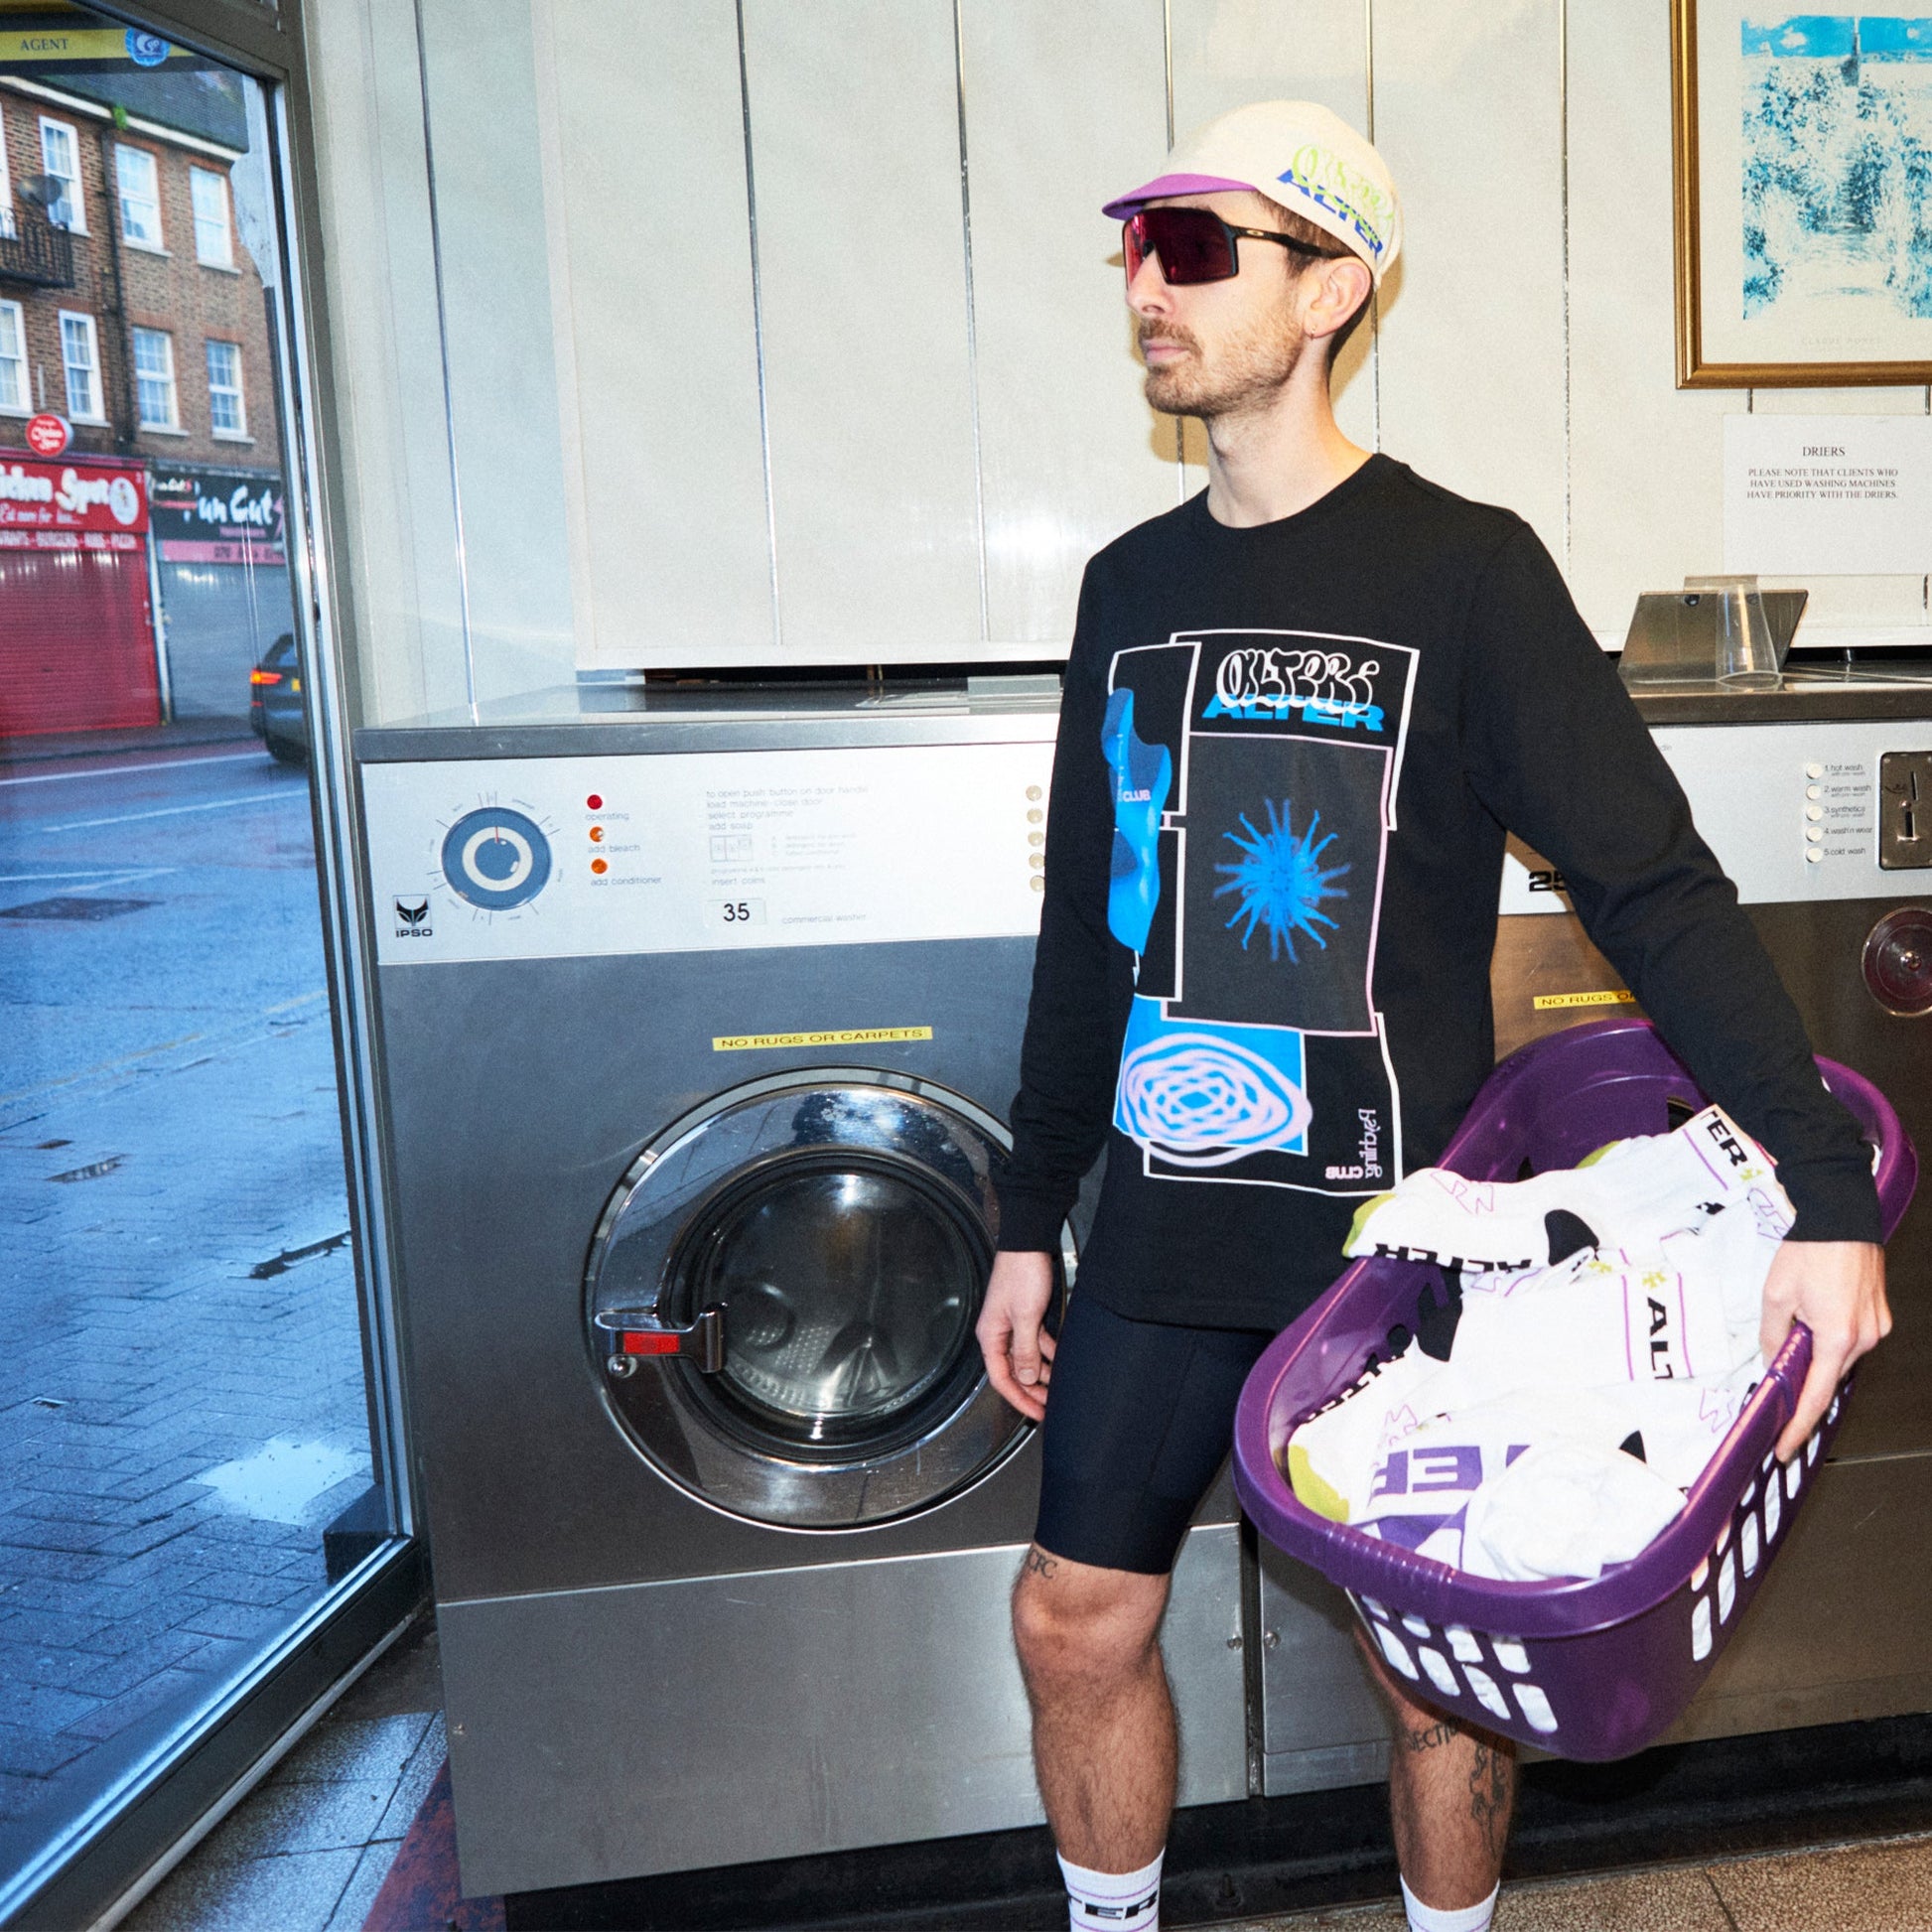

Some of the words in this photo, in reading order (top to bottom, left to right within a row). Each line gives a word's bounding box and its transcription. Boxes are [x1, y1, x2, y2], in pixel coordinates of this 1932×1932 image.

[20, 38, 69, 52] AGENT
[1802, 446, 1846, 457] DRIERS
[1748, 468, 1781, 478] PLEASE
[1786, 468, 1809, 478] NOTE
[1811, 468, 1835, 478] THAT
[1837, 468, 1874, 478] CLIENTS
[1876, 468, 1898, 478] WHO
[1750, 480, 1775, 488] HAVE
[1778, 480, 1802, 488] USED
[1804, 480, 1847, 488] WASHING
[1849, 480, 1896, 488] MACHINES
[1747, 490, 1771, 499] HAVE
[1775, 490, 1817, 499] PRIORITY
[1819, 490, 1843, 499] WITH
[1845, 490, 1862, 499] THE
[1122, 789, 1152, 802] CLUB
[585, 812, 630, 822] operating
[609, 844, 641, 854] bleach
[611, 877, 662, 887] conditioner
[723, 902, 751, 922] 35
[395, 928, 434, 938] IPSO
[1542, 996, 1565, 1006] NO
[1569, 994, 1613, 1004] RUGS
[721, 1037, 749, 1047] NO
[754, 1035, 804, 1045] RUGS
[809, 1034, 835, 1042] OR
[840, 1029, 923, 1041] CARPETS
